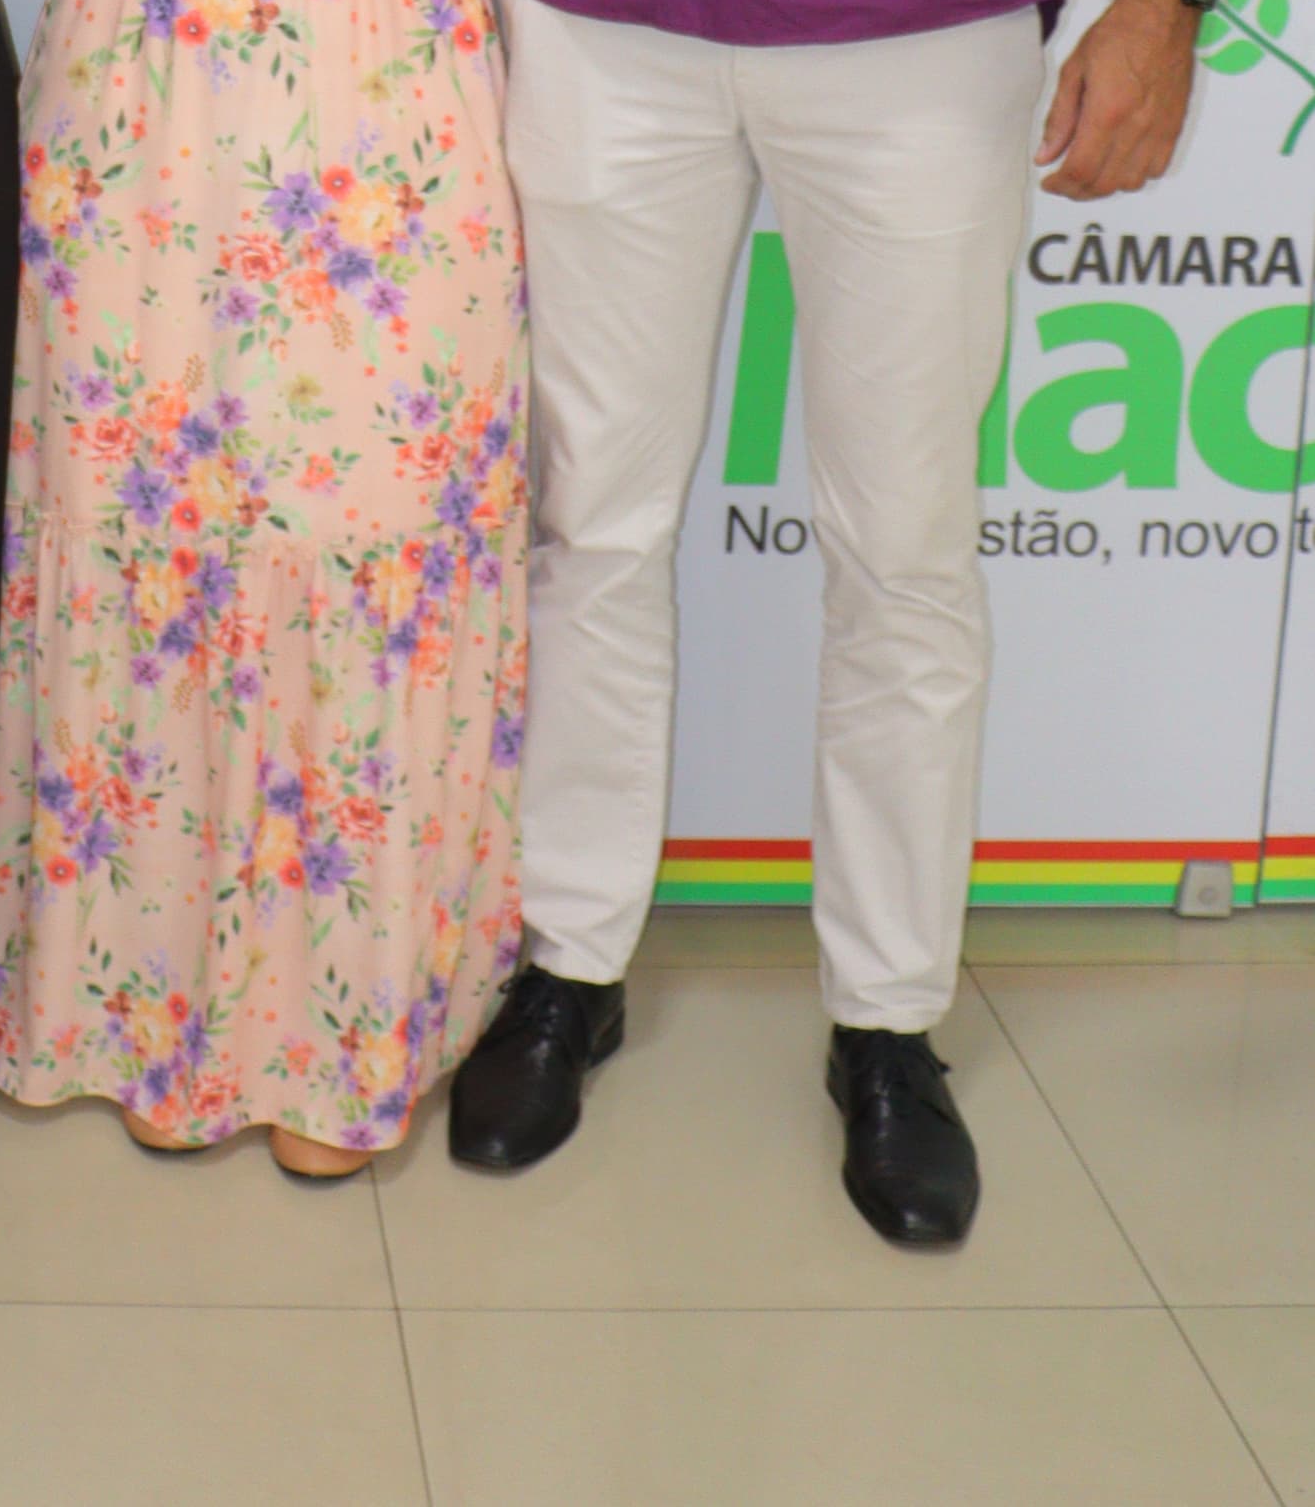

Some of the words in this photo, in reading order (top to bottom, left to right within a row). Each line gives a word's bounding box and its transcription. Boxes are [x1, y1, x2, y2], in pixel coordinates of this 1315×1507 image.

[1028, 224, 1303, 287] CÂMARA
[977, 509, 1113, 566] stão,
[1139, 518, 1279, 556] novo
